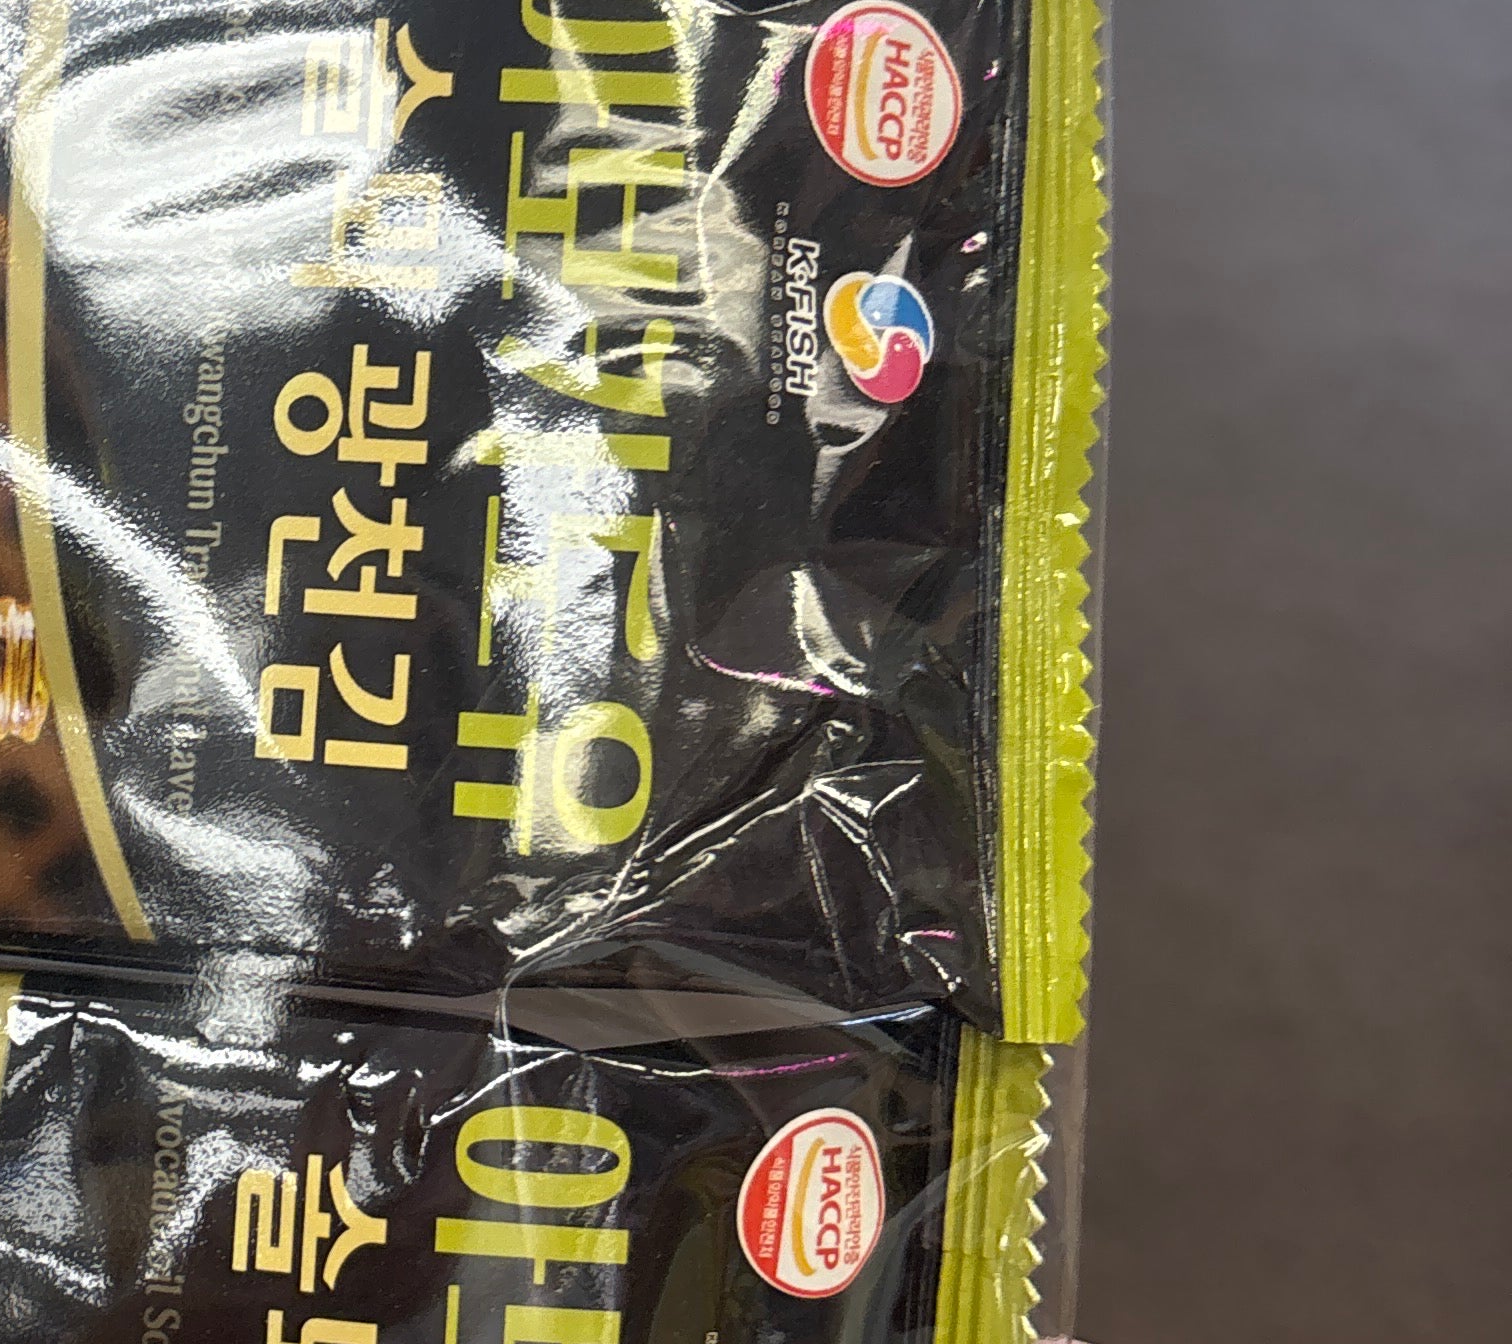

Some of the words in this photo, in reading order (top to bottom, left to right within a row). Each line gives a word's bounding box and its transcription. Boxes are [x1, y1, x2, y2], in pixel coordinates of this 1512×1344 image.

[876, 37, 912, 162] HACCP
[182, 316, 237, 510] wangchun
[253, 344, 433, 771] 광천김
[815, 1146, 843, 1271] HACCP
